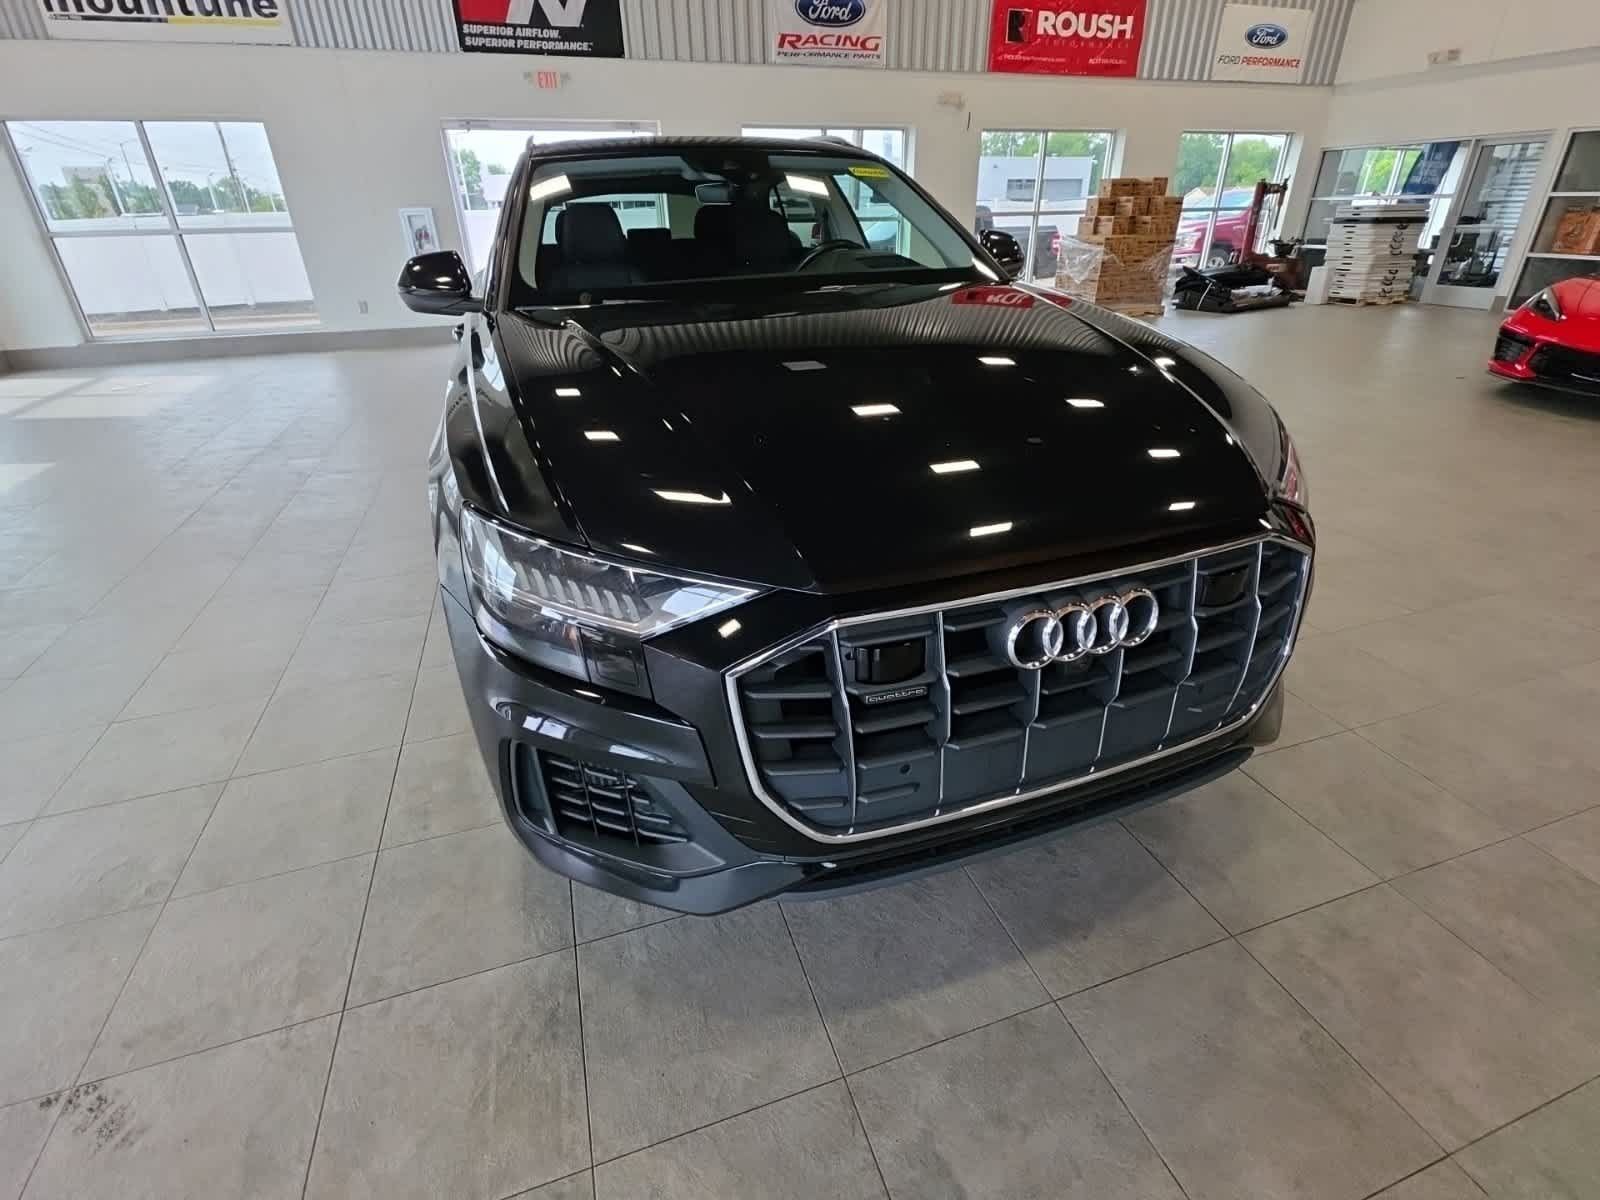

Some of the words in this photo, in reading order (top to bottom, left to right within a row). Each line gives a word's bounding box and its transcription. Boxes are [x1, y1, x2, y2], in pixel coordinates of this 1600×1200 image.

[463, 24, 513, 36] SUPERIOR
[515, 28, 561, 39] AIRFLOW.
[1036, 10, 1134, 39] ROUSH
[465, 36, 515, 48] SUPERIOR
[777, 33, 882, 51] RACING
[1252, 27, 1280, 45] Ford
[1218, 55, 1240, 65] FORD
[1241, 56, 1300, 68] PERFORMANCE
[538, 71, 557, 89] EXIT
